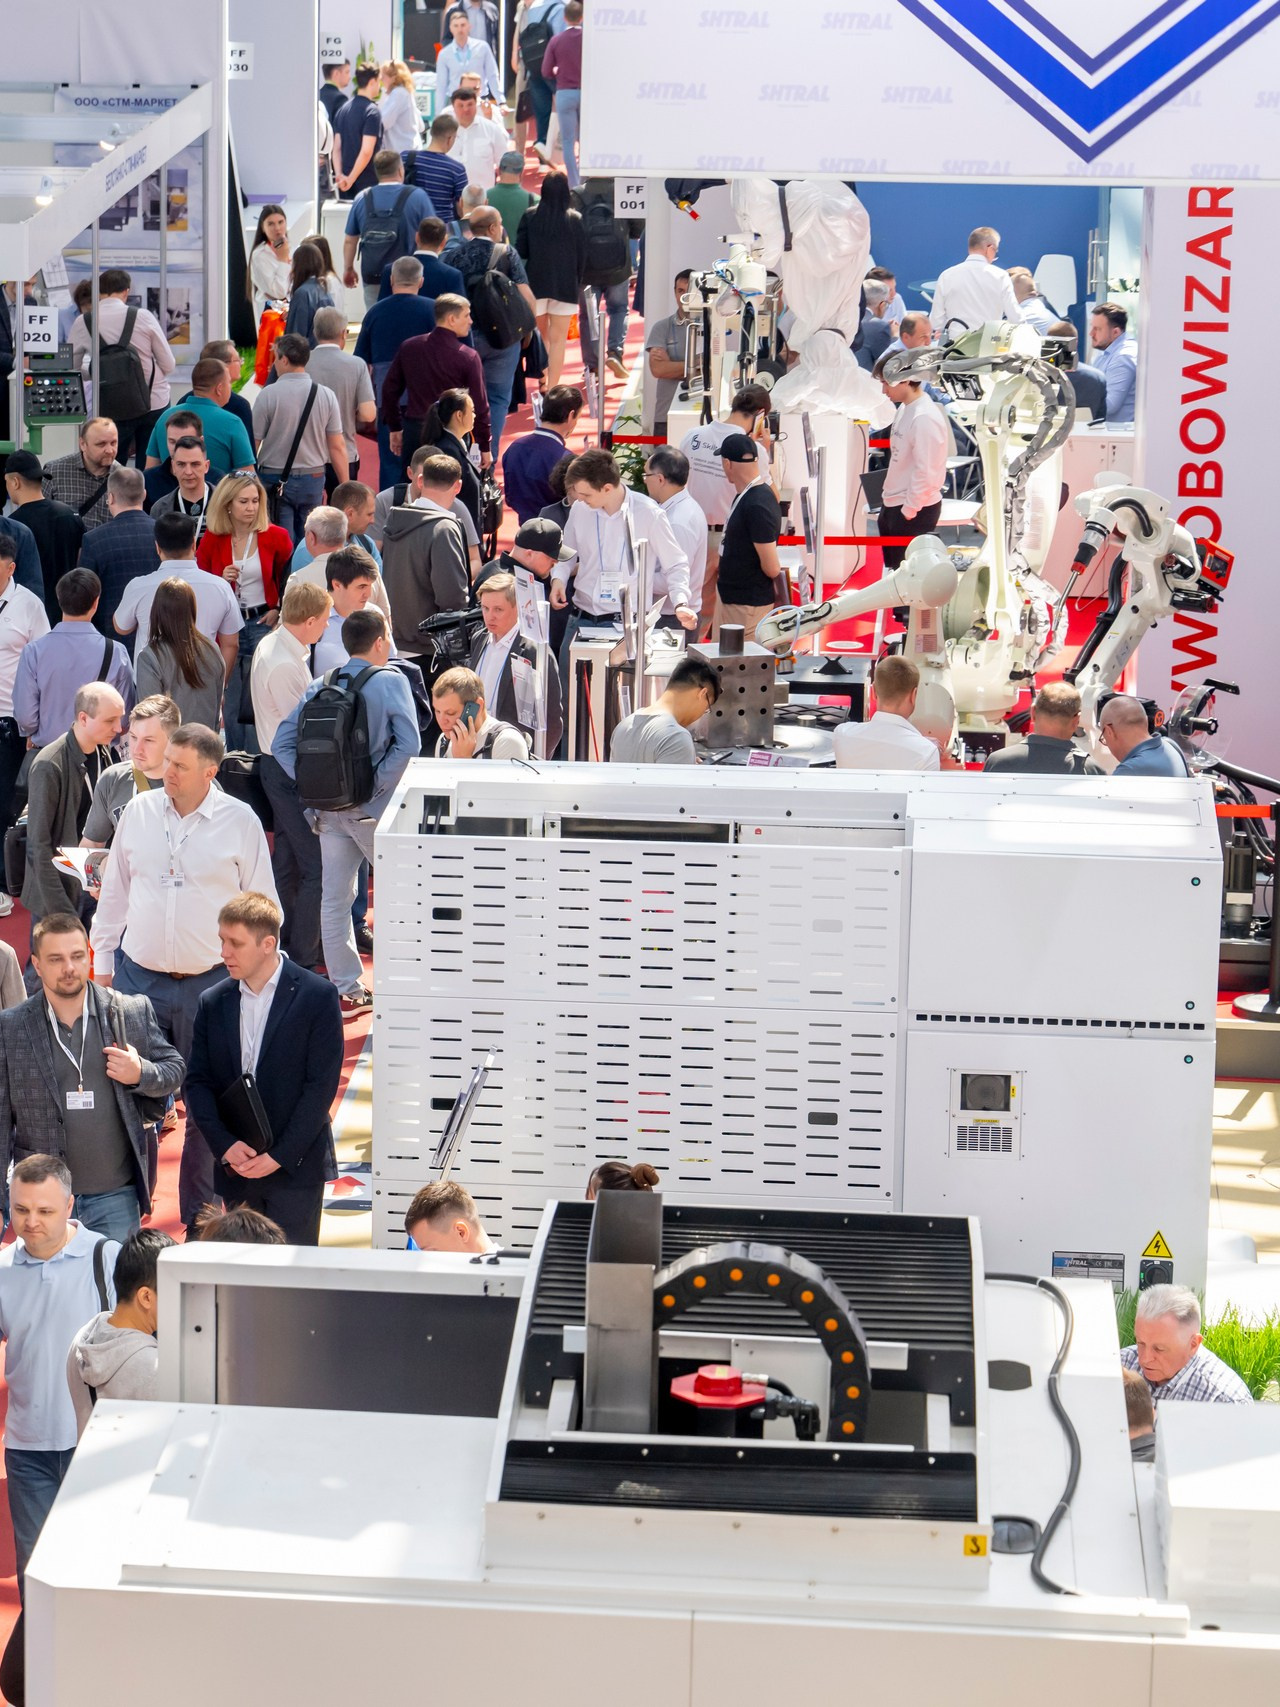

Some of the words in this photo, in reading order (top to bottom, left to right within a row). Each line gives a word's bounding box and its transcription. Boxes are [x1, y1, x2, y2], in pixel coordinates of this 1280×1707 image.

[699, 11, 769, 28] SHTRAL
[821, 12, 893, 30] SHTRAL
[637, 82, 707, 100] SHTRAL
[758, 84, 830, 102] SHTRAL
[881, 86, 953, 104] SHTRAL
[74, 97, 99, 107] ООО
[696, 156, 766, 170] SHTRAL
[818, 158, 888, 173] SHTRAL
[626, 185, 644, 194] FF
[620, 200, 645, 210] 001
[28, 315, 48, 325] FF
[23, 332, 52, 343] 020
